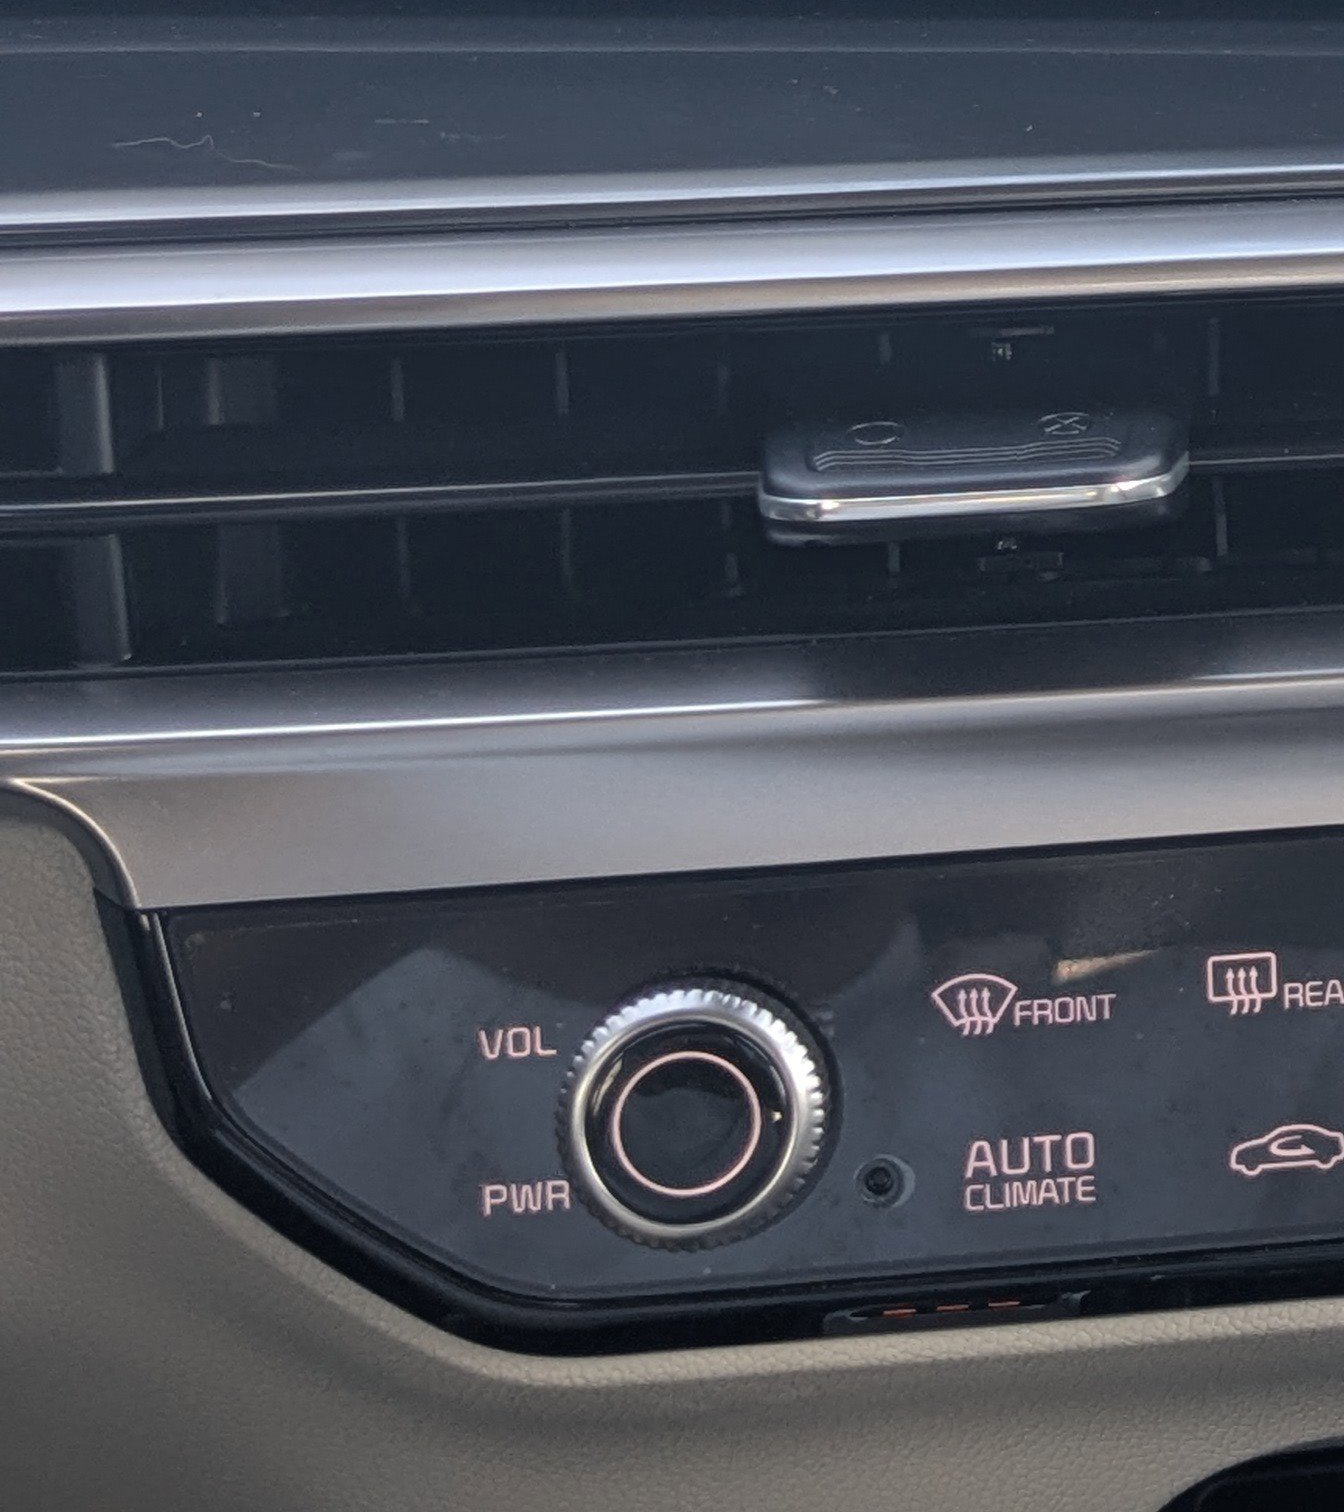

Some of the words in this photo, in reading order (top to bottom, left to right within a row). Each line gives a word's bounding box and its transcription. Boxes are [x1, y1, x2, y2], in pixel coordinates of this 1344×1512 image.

[1013, 993, 1116, 1027] FRONT
[477, 1026, 557, 1059] VOL
[966, 1132, 1096, 1178] AUTO
[482, 1180, 571, 1216] PWR
[965, 1175, 1097, 1211] CLIMATE
